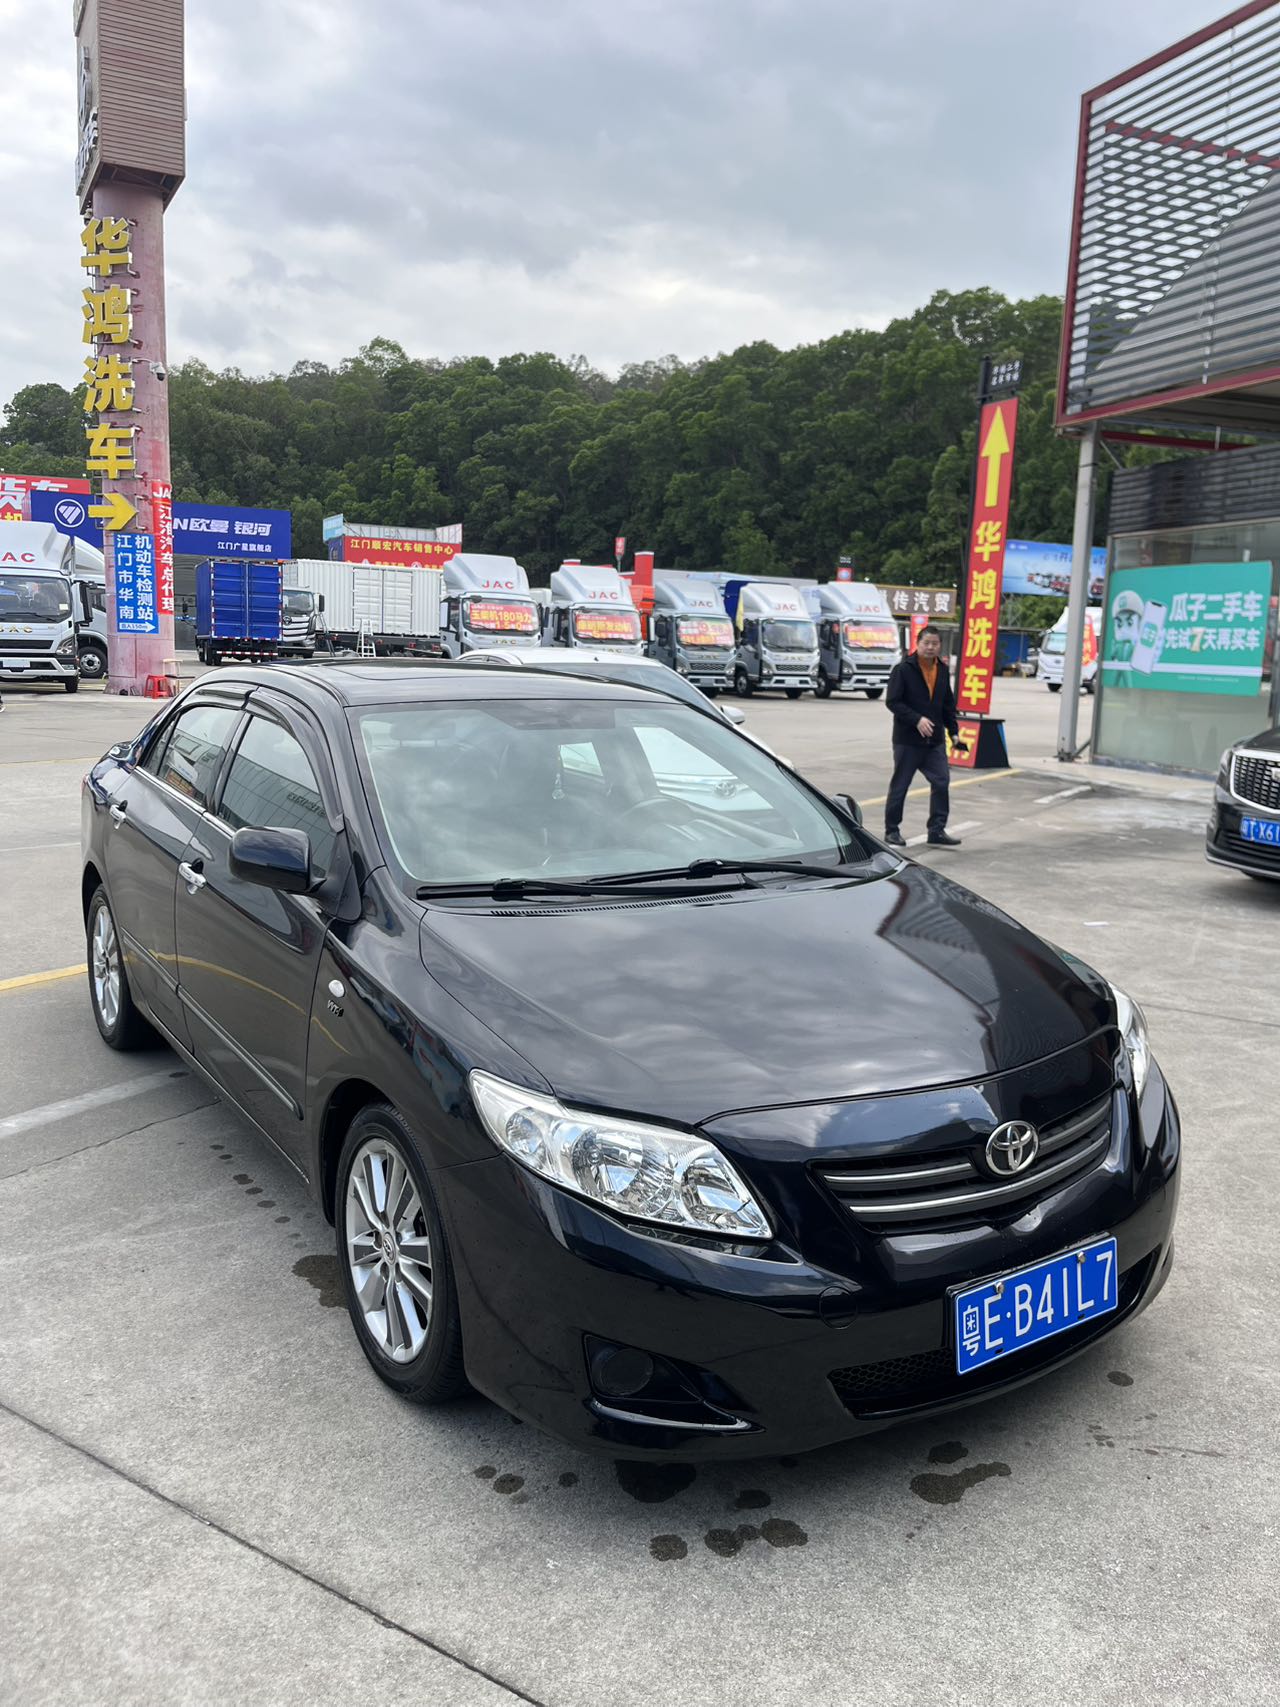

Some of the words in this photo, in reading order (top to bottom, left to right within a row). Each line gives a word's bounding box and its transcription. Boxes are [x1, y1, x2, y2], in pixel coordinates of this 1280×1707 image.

[81, 217, 136, 480] 华鸿洗车
[234, 521, 272, 537] 银河
[117, 535, 134, 620] 江门市华南
[135, 535, 154, 621] 机动车检测站
[482, 580, 515, 590] JAC
[589, 591, 619, 600] JAC
[690, 600, 714, 608] JAC
[775, 603, 797, 611] JAC
[855, 604, 881, 613] JAC
[1168, 590, 1264, 623] 瓜子二手车
[960, 520, 1002, 706] 华鸿洗车
[944, 726, 977, 760] 行
[962, 1250, 1113, 1357] 粤E·B41L7
